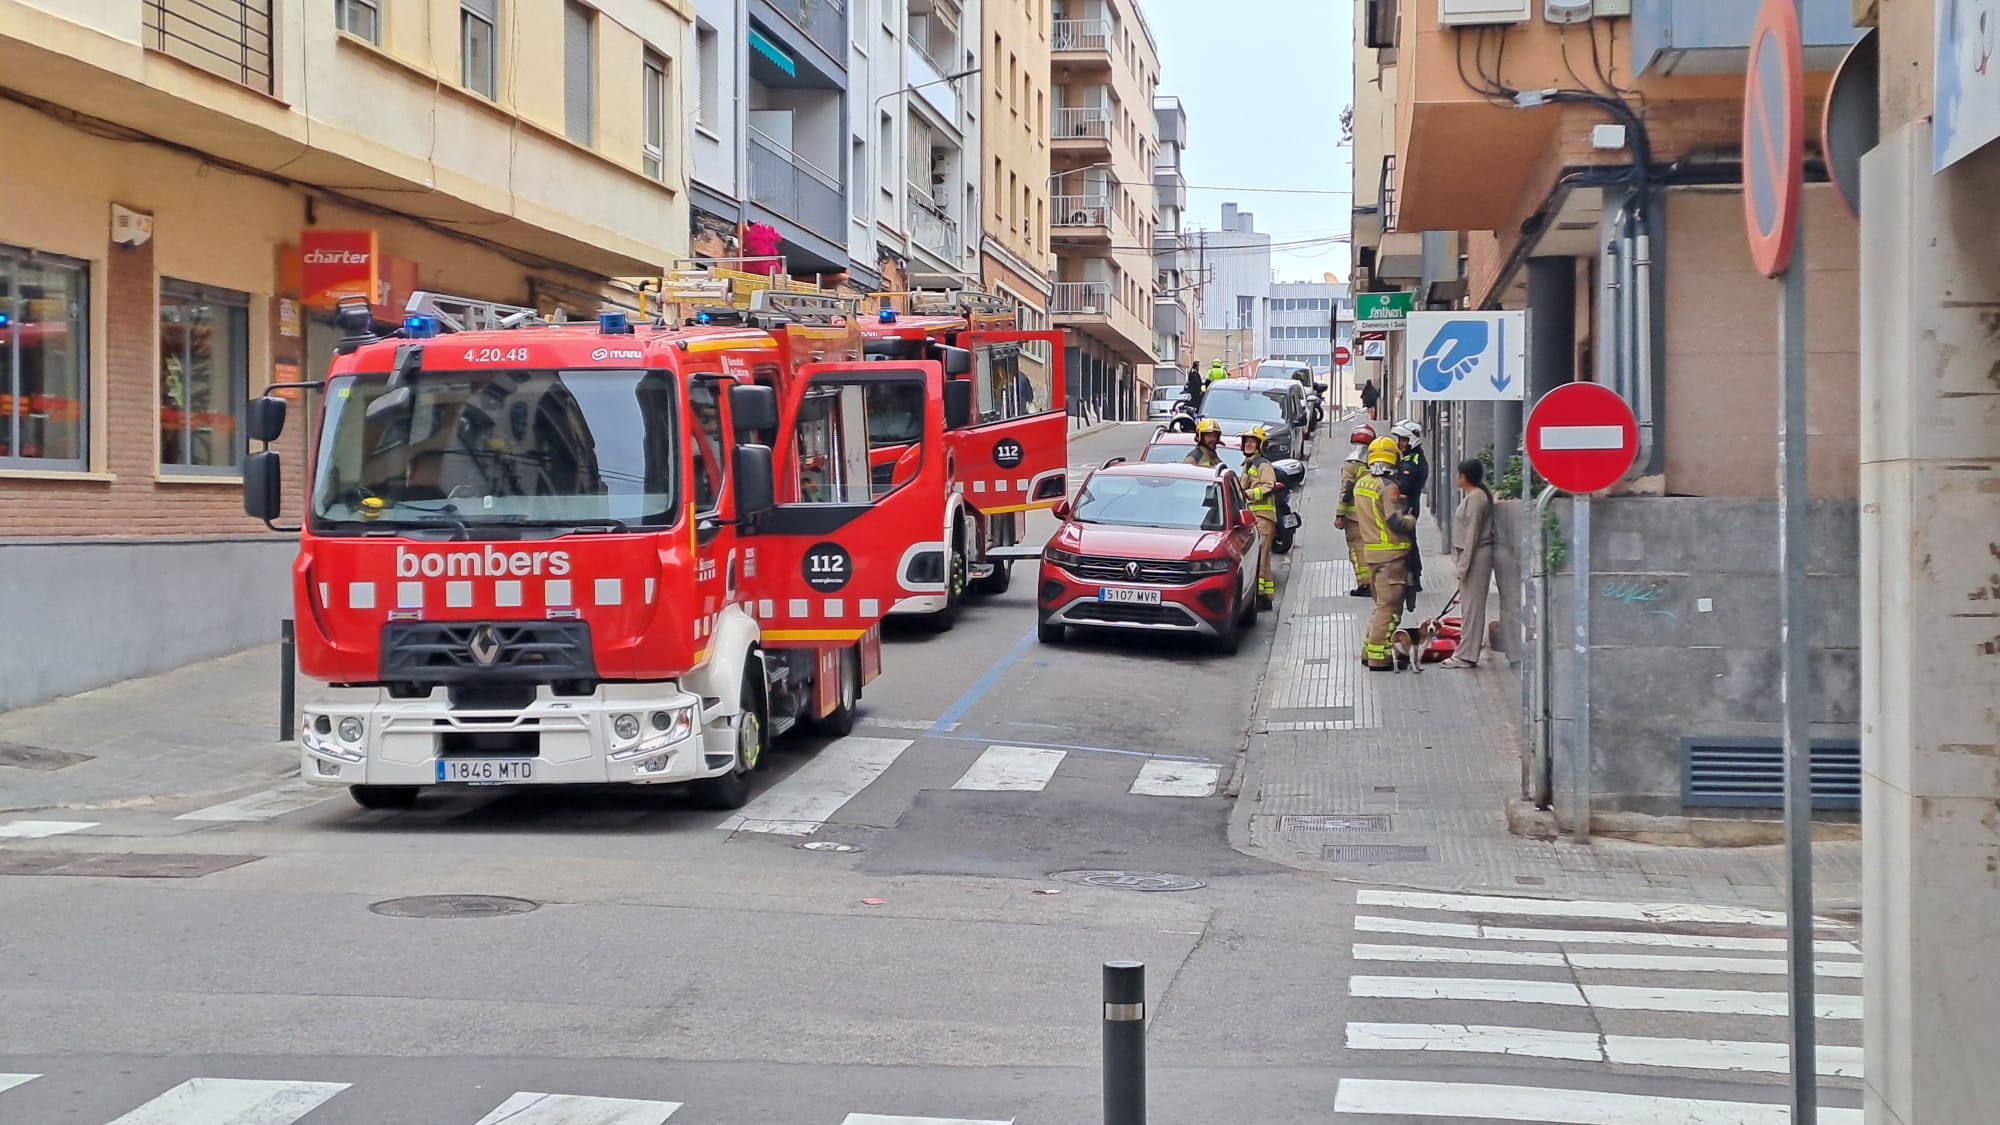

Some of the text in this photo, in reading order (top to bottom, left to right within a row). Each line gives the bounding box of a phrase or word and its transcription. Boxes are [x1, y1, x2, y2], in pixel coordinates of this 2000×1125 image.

[303, 249, 370, 264] charter
[463, 348, 528, 362] 4.20.48
[997, 445, 1019, 457] 112
[396, 544, 570, 577] bombers
[810, 555, 844, 572] 112
[1107, 589, 1158, 602] 5107 MVR
[451, 762, 532, 779] 1846 MTD
